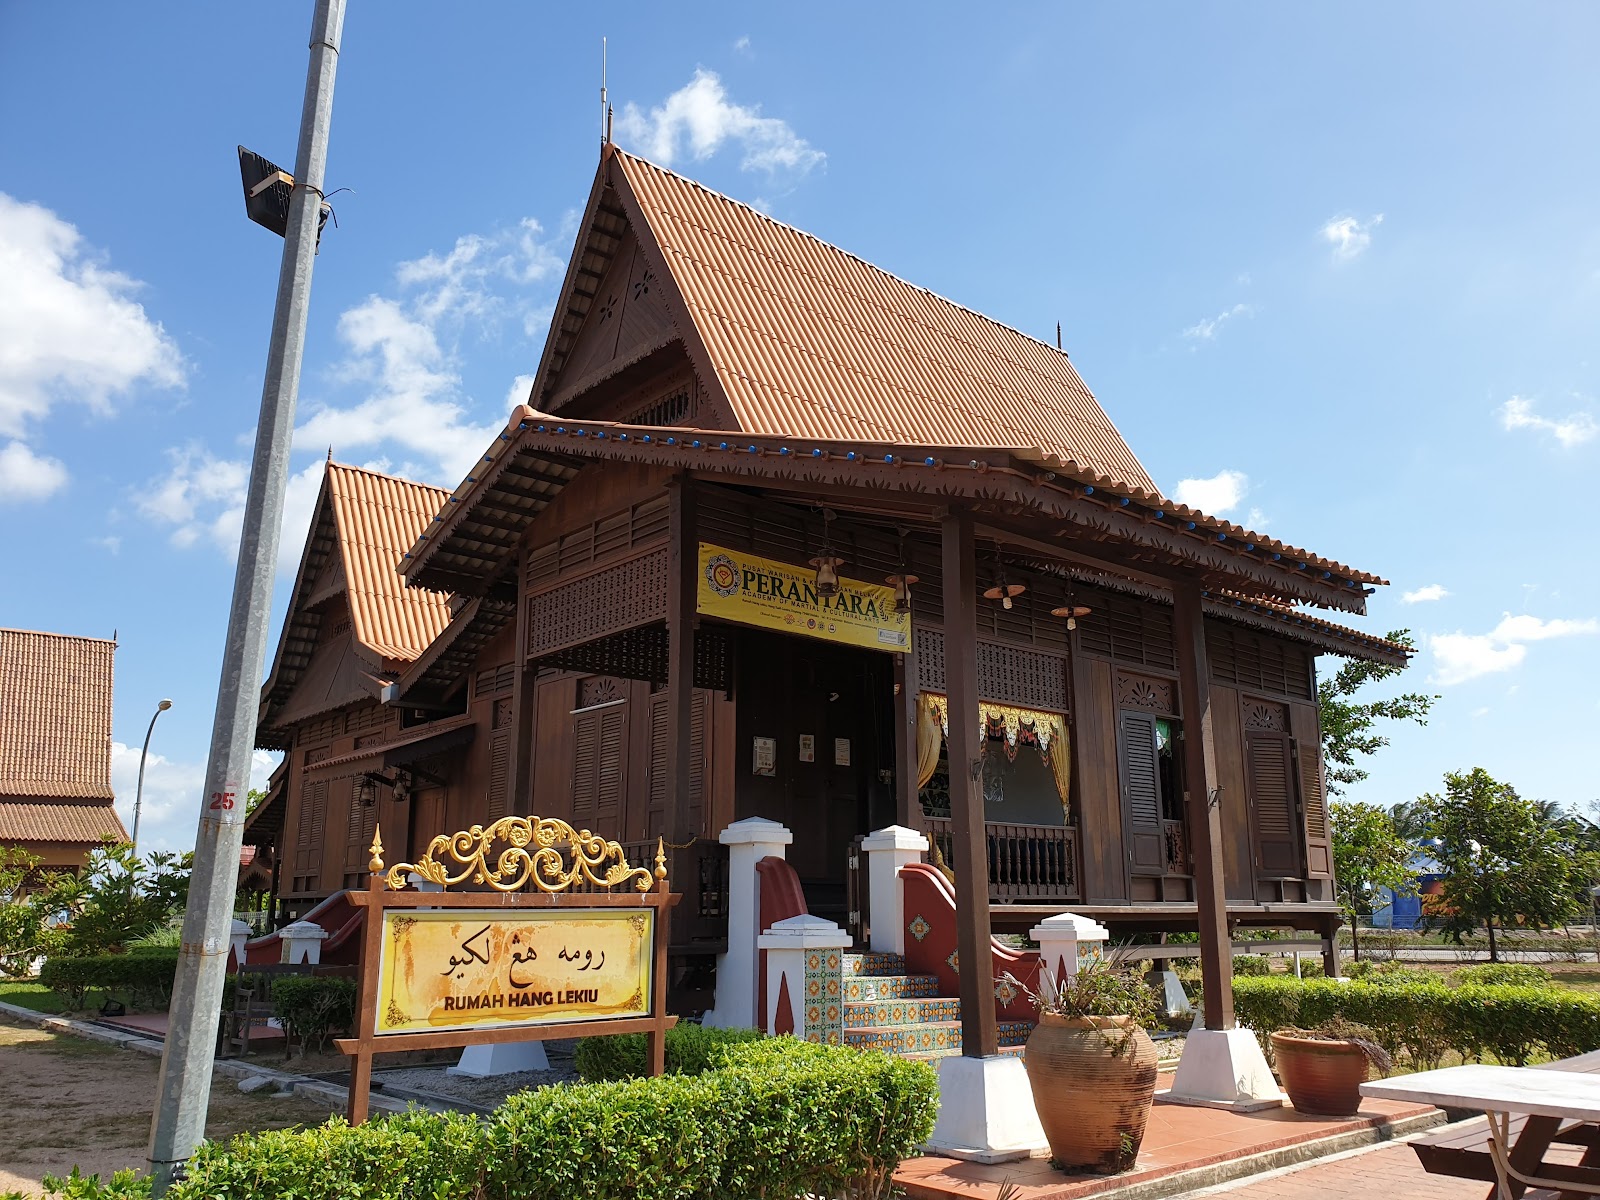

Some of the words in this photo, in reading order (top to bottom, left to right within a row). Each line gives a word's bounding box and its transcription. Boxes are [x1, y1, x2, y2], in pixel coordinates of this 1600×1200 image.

[742, 564, 765, 573] PUSAT
[768, 570, 800, 582] WARISAN
[854, 589, 879, 600] MELAYU
[742, 590, 777, 602] ACADEMY
[791, 601, 819, 612] MARTIAL
[829, 609, 862, 620] CULTURAL
[864, 616, 880, 624] ARTS
[210, 791, 235, 810] 25
[444, 994, 504, 1011] RUMAH
[508, 991, 553, 1008] HANG
[557, 989, 599, 1004] LEKIU
